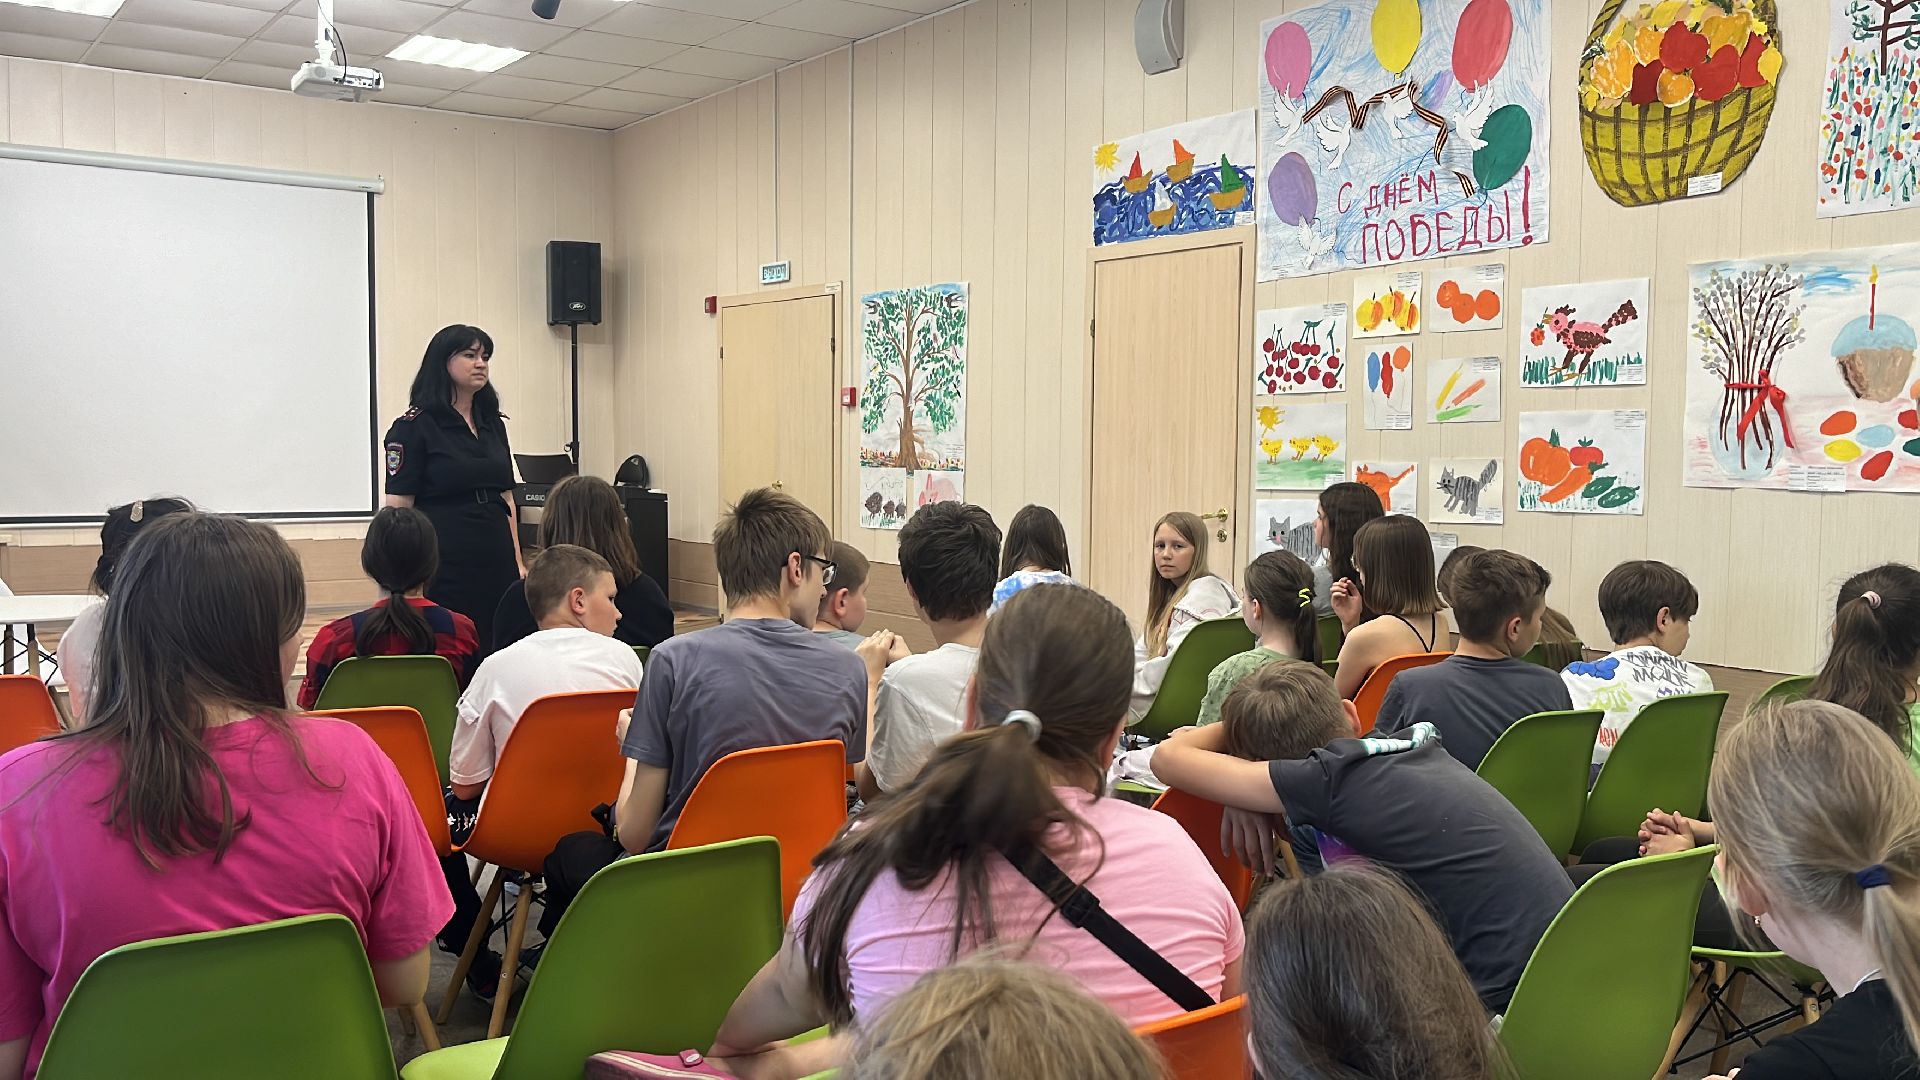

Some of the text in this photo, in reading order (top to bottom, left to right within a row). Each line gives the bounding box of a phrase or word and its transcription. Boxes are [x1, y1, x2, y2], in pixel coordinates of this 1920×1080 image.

[1337, 169, 1439, 219] С ДНЁМ
[1362, 165, 1534, 264] ПОБЕДЫ!
